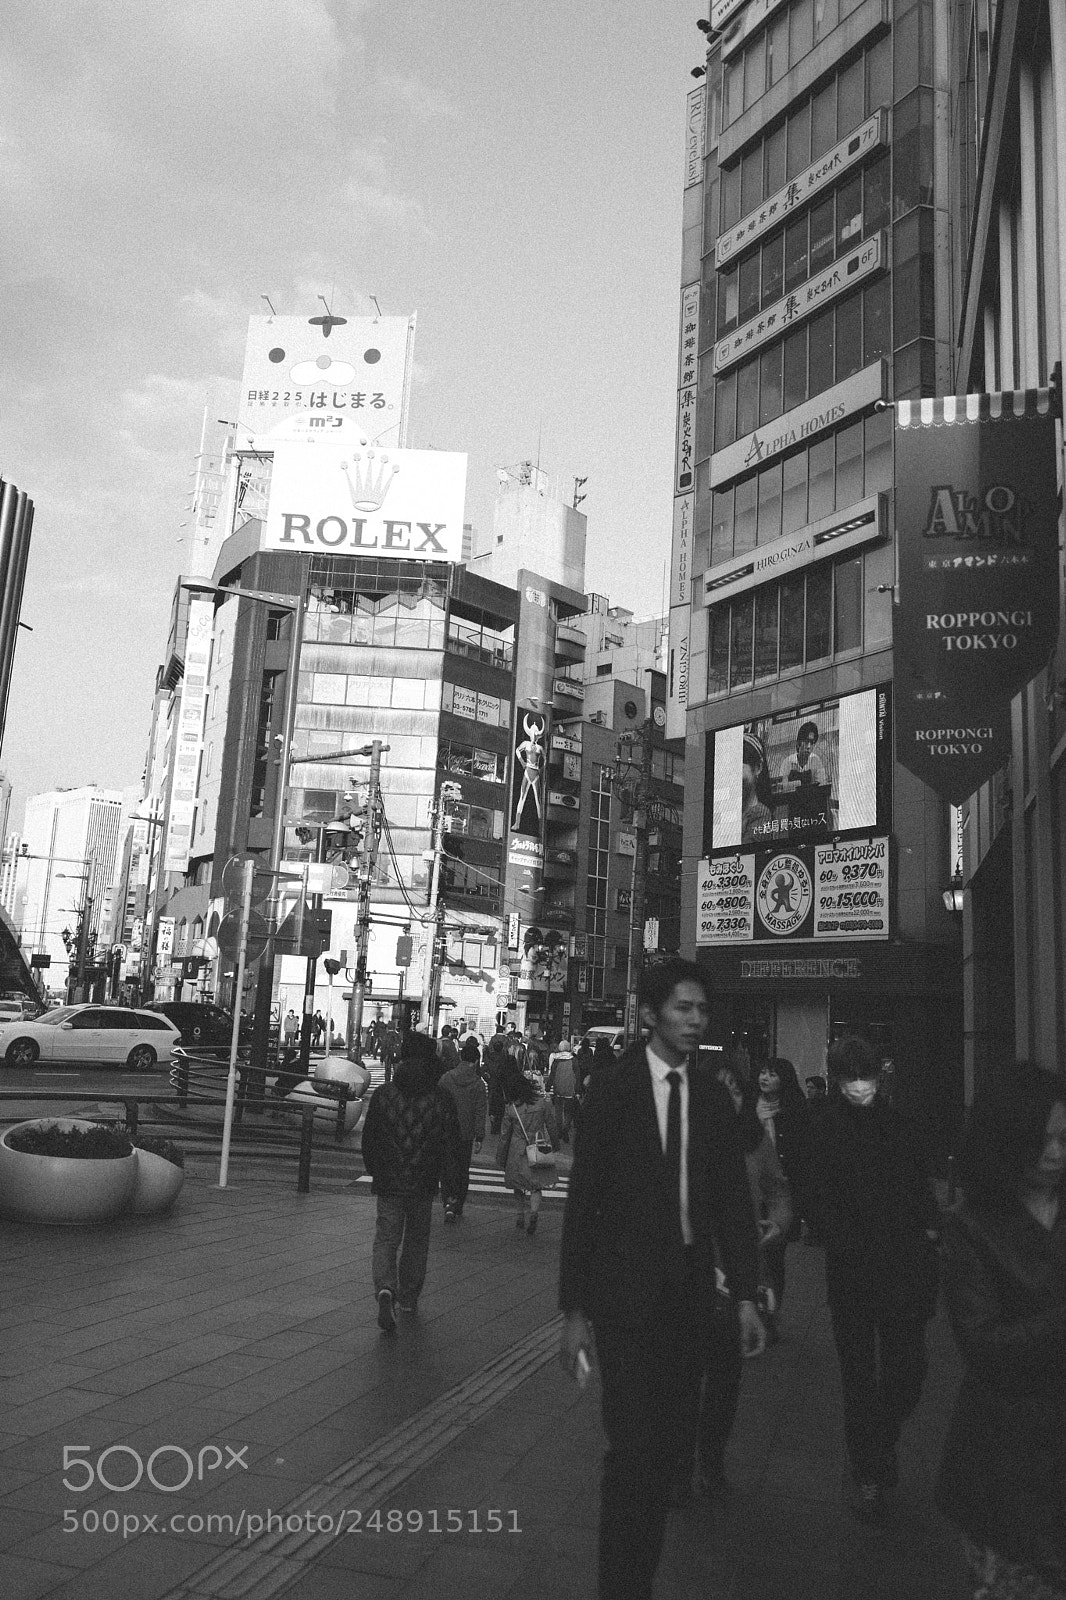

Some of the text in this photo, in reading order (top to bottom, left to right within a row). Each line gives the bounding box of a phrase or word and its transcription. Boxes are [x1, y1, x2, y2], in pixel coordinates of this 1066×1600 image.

[782, 183, 803, 211] 集
[861, 126, 875, 144] 7F
[780, 295, 801, 324] 集
[860, 249, 874, 266] 6F
[679, 390, 696, 408] 集
[744, 402, 847, 468] ALPHA HOMES
[279, 513, 448, 553] ROLEX
[678, 498, 690, 602] ALPHA HOMES
[926, 610, 1033, 630] ROPPONGI
[942, 633, 1018, 651] TOKYO
[915, 727, 994, 741] ROPPONGI
[927, 743, 983, 756] TOKYO
[817, 843, 885, 865] アロマオイルリンパ
[709, 861, 745, 876] もみほぐし
[764, 911, 802, 930] MASSAGE
[739, 958, 859, 978] DIFFERENCE
